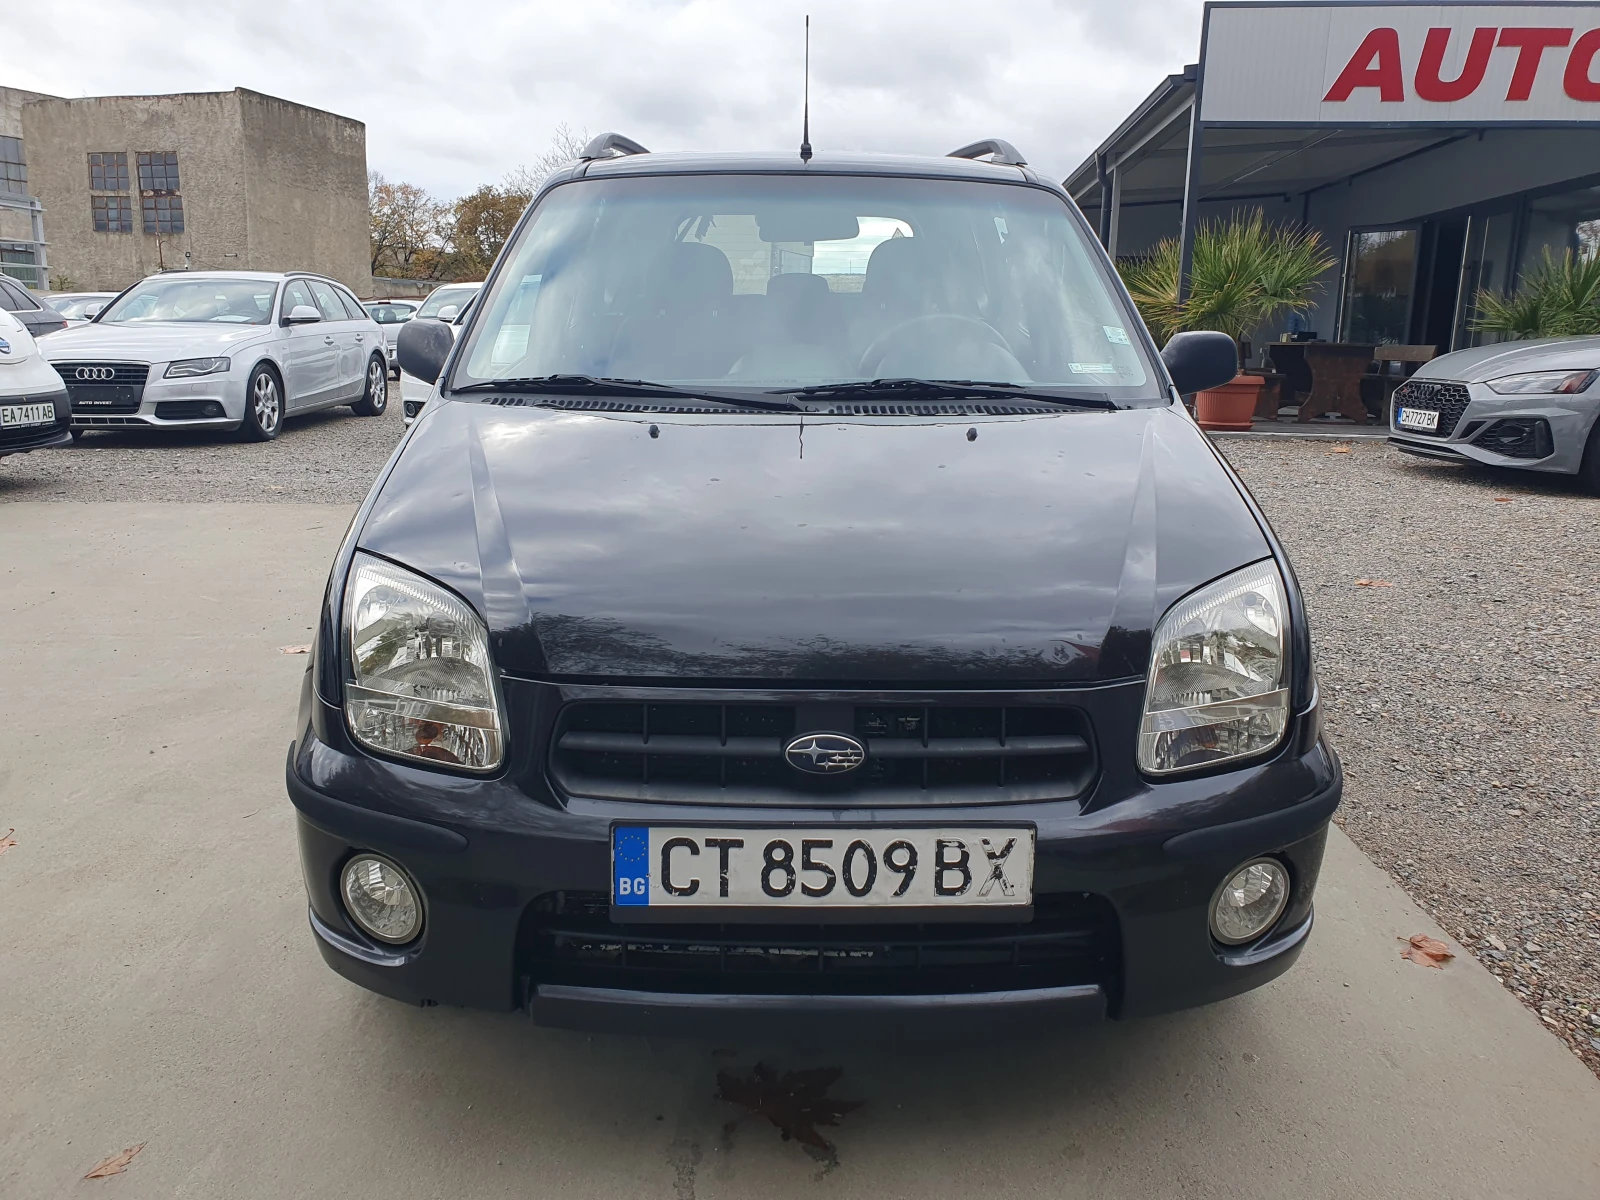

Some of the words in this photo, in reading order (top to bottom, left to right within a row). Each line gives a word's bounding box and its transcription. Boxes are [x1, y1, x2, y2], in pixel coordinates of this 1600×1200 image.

[619, 876, 646, 896] BG
[660, 836, 745, 898] CT
[760, 838, 919, 899] 8509
[933, 836, 1019, 898] BX
